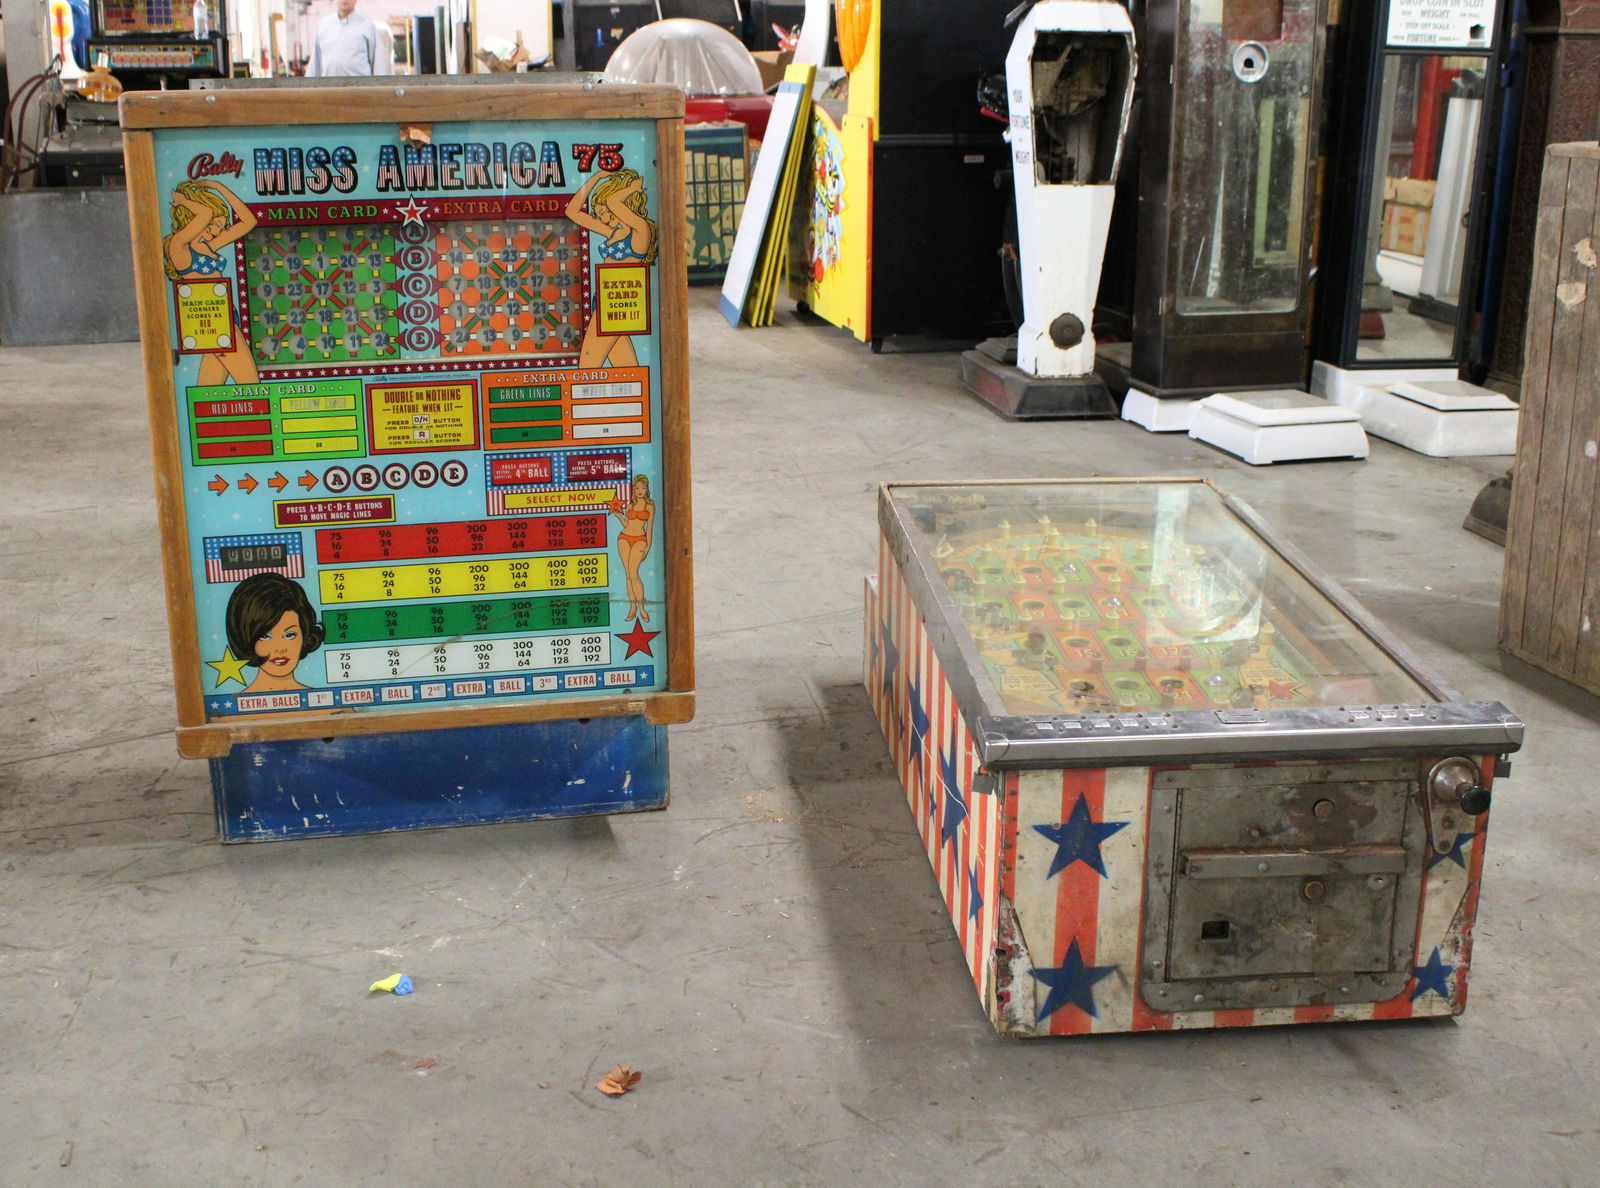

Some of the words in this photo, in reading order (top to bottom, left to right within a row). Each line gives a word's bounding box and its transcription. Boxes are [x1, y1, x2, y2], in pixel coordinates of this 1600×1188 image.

[1421, 9, 1450, 19] WEIGHT
[187, 151, 245, 179] Bally
[253, 146, 358, 195] MISS
[376, 141, 566, 193] AMERICA
[572, 143, 623, 172] 75
[268, 207, 320, 221] MAIN
[328, 205, 378, 219] CARD
[443, 201, 503, 215] EXTRA
[511, 200, 560, 213] CARD
[602, 280, 643, 289] EXTRA
[607, 291, 638, 299] CARD
[607, 311, 626, 321] WHEN
[630, 311, 640, 320] LIT
[200, 320, 211, 328] RED
[523, 373, 567, 384] EXTRA
[573, 371, 609, 381] CARD
[232, 387, 270, 397] MAIN
[278, 384, 316, 395] CARD
[384, 391, 413, 404] DOUBLE
[416, 392, 424, 401] OR
[426, 388, 461, 401] NOTHING
[500, 389, 525, 400] GREEN
[528, 387, 551, 399] LINES
[211, 404, 227, 414] RED
[231, 402, 253, 413] LINES
[393, 404, 419, 414] FEATURE
[423, 403, 441, 413] WHEN
[444, 403, 453, 412] LIT
[528, 468, 548, 478] BALL
[604, 465, 624, 474] BALL
[331, 473, 344, 486] A
[361, 472, 373, 485] B
[390, 470, 401, 483] C
[419, 469, 431, 482] D
[449, 467, 459, 479] E
[526, 496, 561, 504] SELECT
[569, 494, 596, 502] NOW
[287, 505, 306, 514] PRESS
[355, 501, 383, 510] BUTTONS
[300, 513, 308, 521] TO
[311, 512, 328, 520] MOVE
[330, 511, 350, 520] MAGIC
[353, 510, 372, 519] LINES
[333, 573, 344, 582] 75
[469, 565, 489, 573] 200
[509, 562, 529, 571] 300
[547, 560, 568, 568] 400
[577, 558, 598, 566] 600
[473, 574, 485, 582] 96
[549, 569, 565, 577] 192
[577, 567, 598, 575] 400
[514, 581, 526, 589] 64
[550, 578, 565, 586] 128
[340, 653, 351, 661] 75
[434, 647, 446, 655] 96
[473, 644, 493, 652] 200
[513, 641, 533, 649] 300
[580, 636, 601, 644] 600
[341, 662, 351, 670] 16
[477, 653, 489, 661] 96
[515, 650, 531, 658] 144
[553, 648, 569, 656] 192
[581, 645, 601, 653] 400
[478, 662, 489, 670] 32
[517, 659, 530, 667] 64
[568, 675, 595, 686] EXTRA
[610, 672, 632, 683] BALL
[456, 682, 484, 694] EXTRA
[500, 680, 521, 691] BALL
[344, 691, 372, 702] EXTRA
[387, 688, 409, 699] BALL
[240, 698, 268, 709] EXTRA
[272, 696, 299, 707] BALLS
